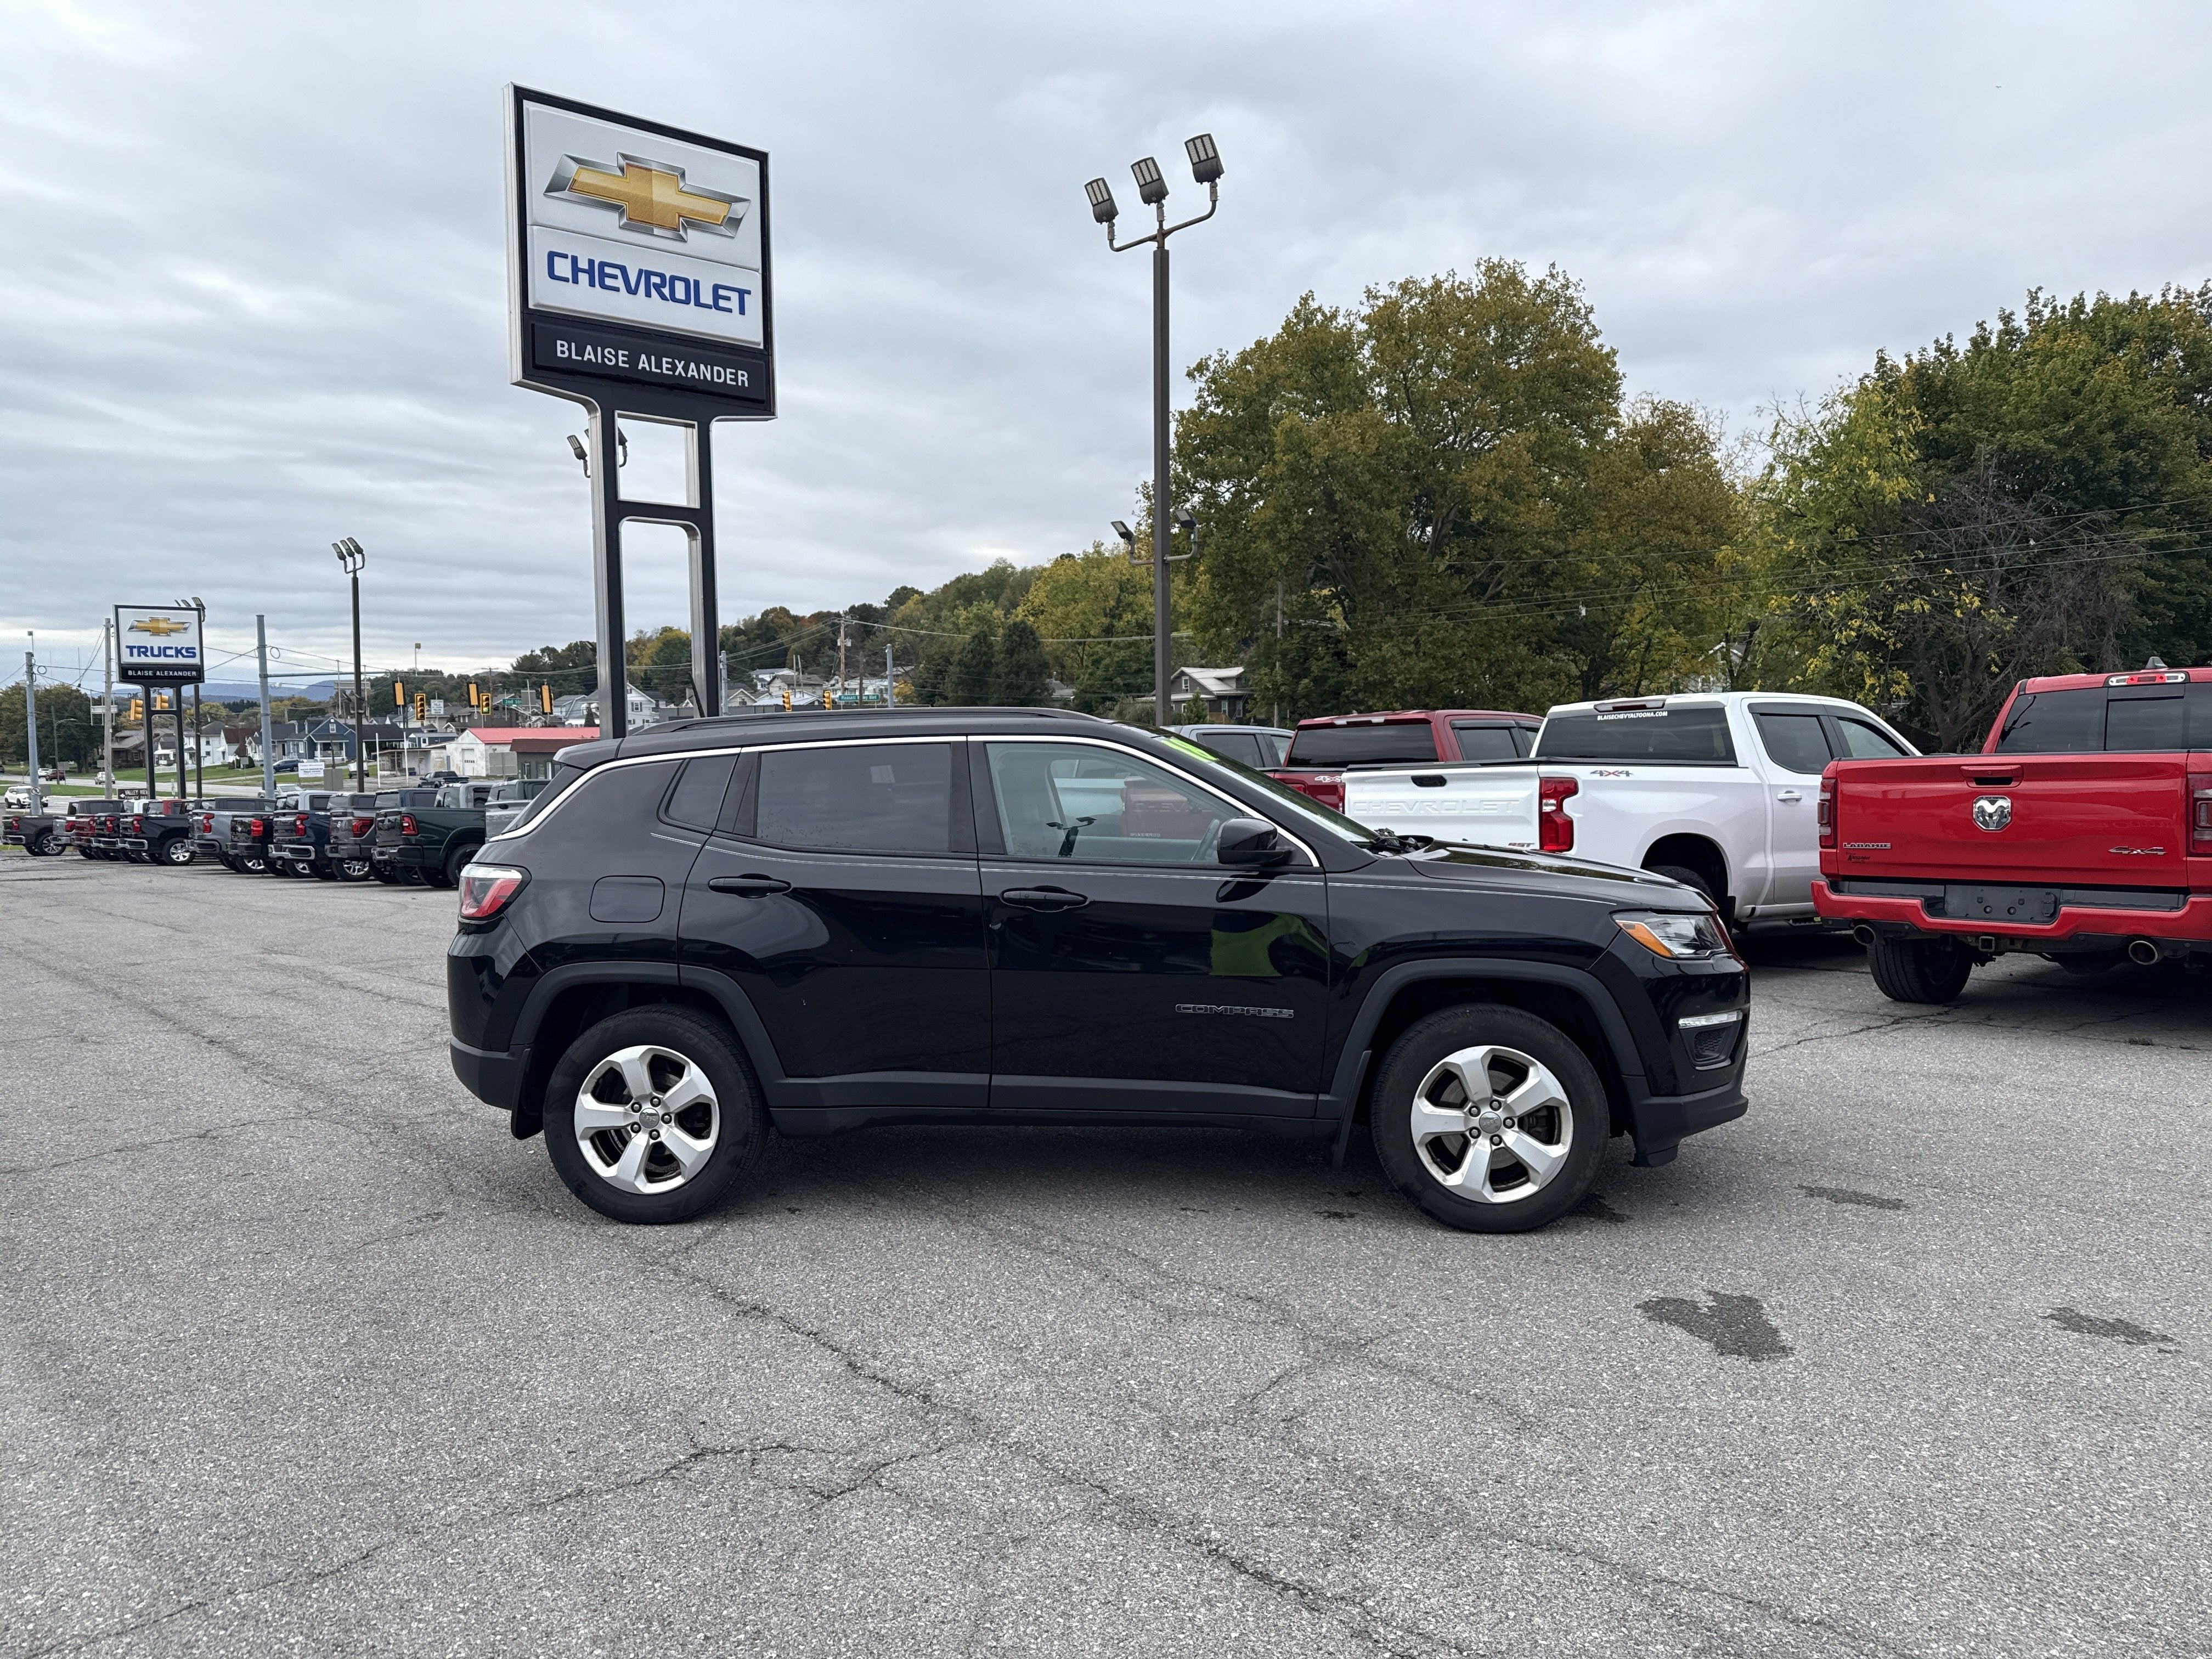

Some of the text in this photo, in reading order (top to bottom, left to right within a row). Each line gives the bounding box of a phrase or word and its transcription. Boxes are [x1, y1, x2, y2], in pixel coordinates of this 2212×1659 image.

[547, 250, 751, 315] CHEVROLET
[556, 340, 749, 387] BLAISE ALEXANDER
[126, 645, 196, 658] TRUCKS
[1597, 711, 1668, 721] BLAISECHEVYALTOONA.COM
[1353, 799, 1520, 814] CHEVROLET
[1175, 1003, 1294, 1018] COMPASS
